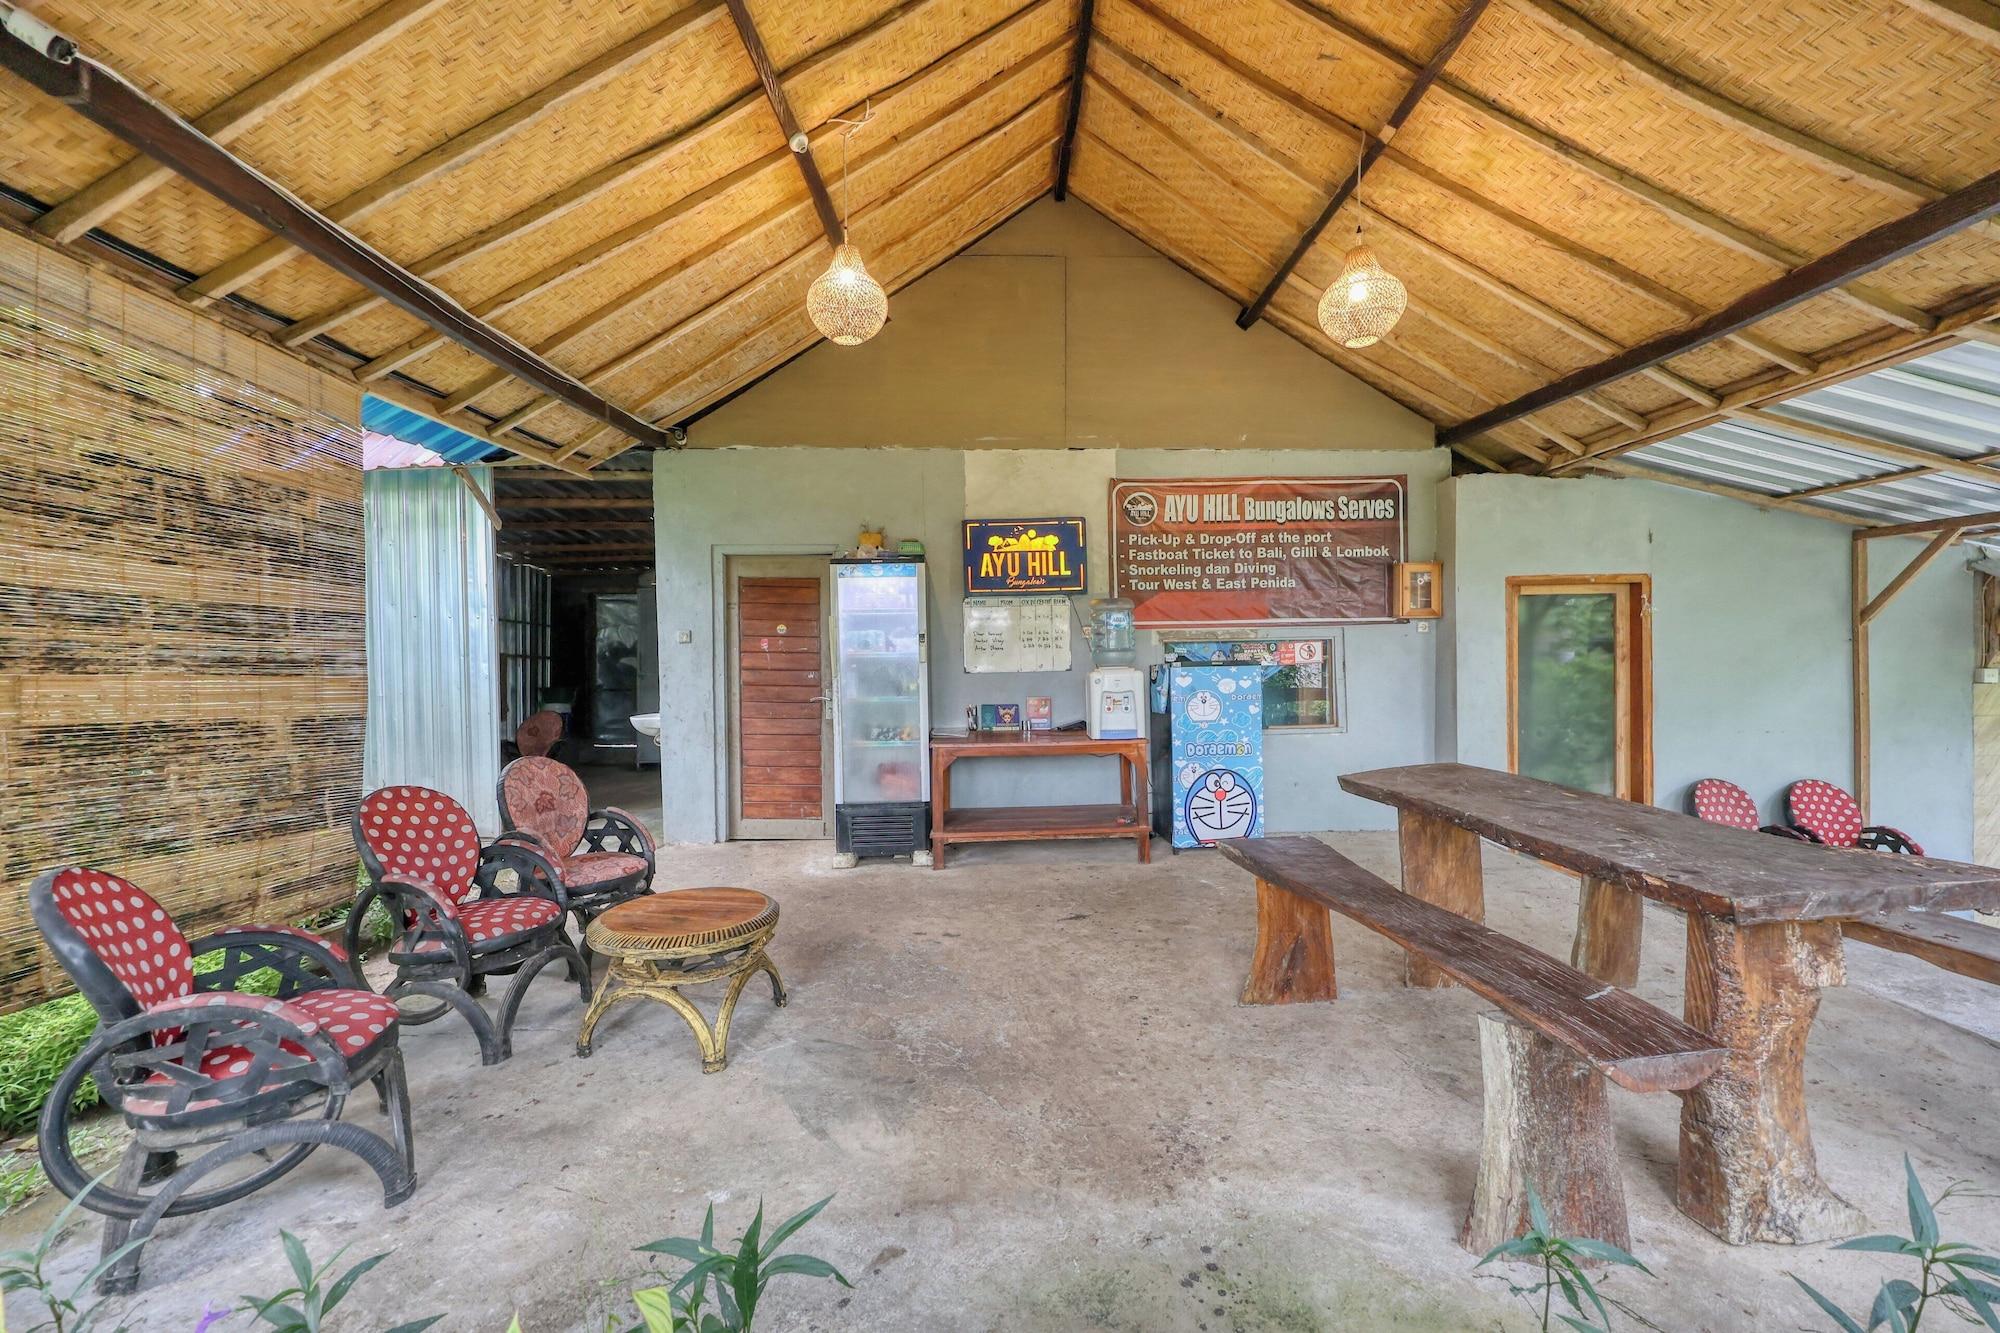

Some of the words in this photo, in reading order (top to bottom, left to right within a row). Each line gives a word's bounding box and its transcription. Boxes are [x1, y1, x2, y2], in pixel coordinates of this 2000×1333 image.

[1165, 495, 1198, 522] AYU
[1203, 493, 1241, 522] HILL
[1244, 496, 1336, 524] Bungalows
[1338, 495, 1395, 521] Serves
[1128, 533, 1181, 547] Pick-Up
[1186, 534, 1196, 545] &
[1200, 532, 1257, 547] Drop-Off
[1260, 534, 1275, 544] at
[1278, 532, 1300, 544] the
[1304, 532, 1332, 546] port
[1128, 548, 1188, 561] Fastboat
[1192, 547, 1235, 560] Ticket
[1239, 548, 1253, 559] to
[1256, 546, 1287, 560] Bali,
[1290, 546, 1318, 559] Gilli
[1321, 546, 1331, 558] &
[1336, 545, 1389, 558] Lombok
[980, 552, 1020, 577] AYU
[1027, 551, 1072, 576] HILL
[1128, 563, 1202, 577] Snorkeling
[1205, 563, 1230, 575] dan
[1234, 562, 1277, 577] Diving
[1129, 579, 1160, 591] Tour
[1163, 578, 1197, 590] West
[1202, 578, 1212, 590] &
[1216, 577, 1247, 589] East
[1251, 576, 1296, 589] Penida
[1185, 741, 1253, 758] Doraemon
